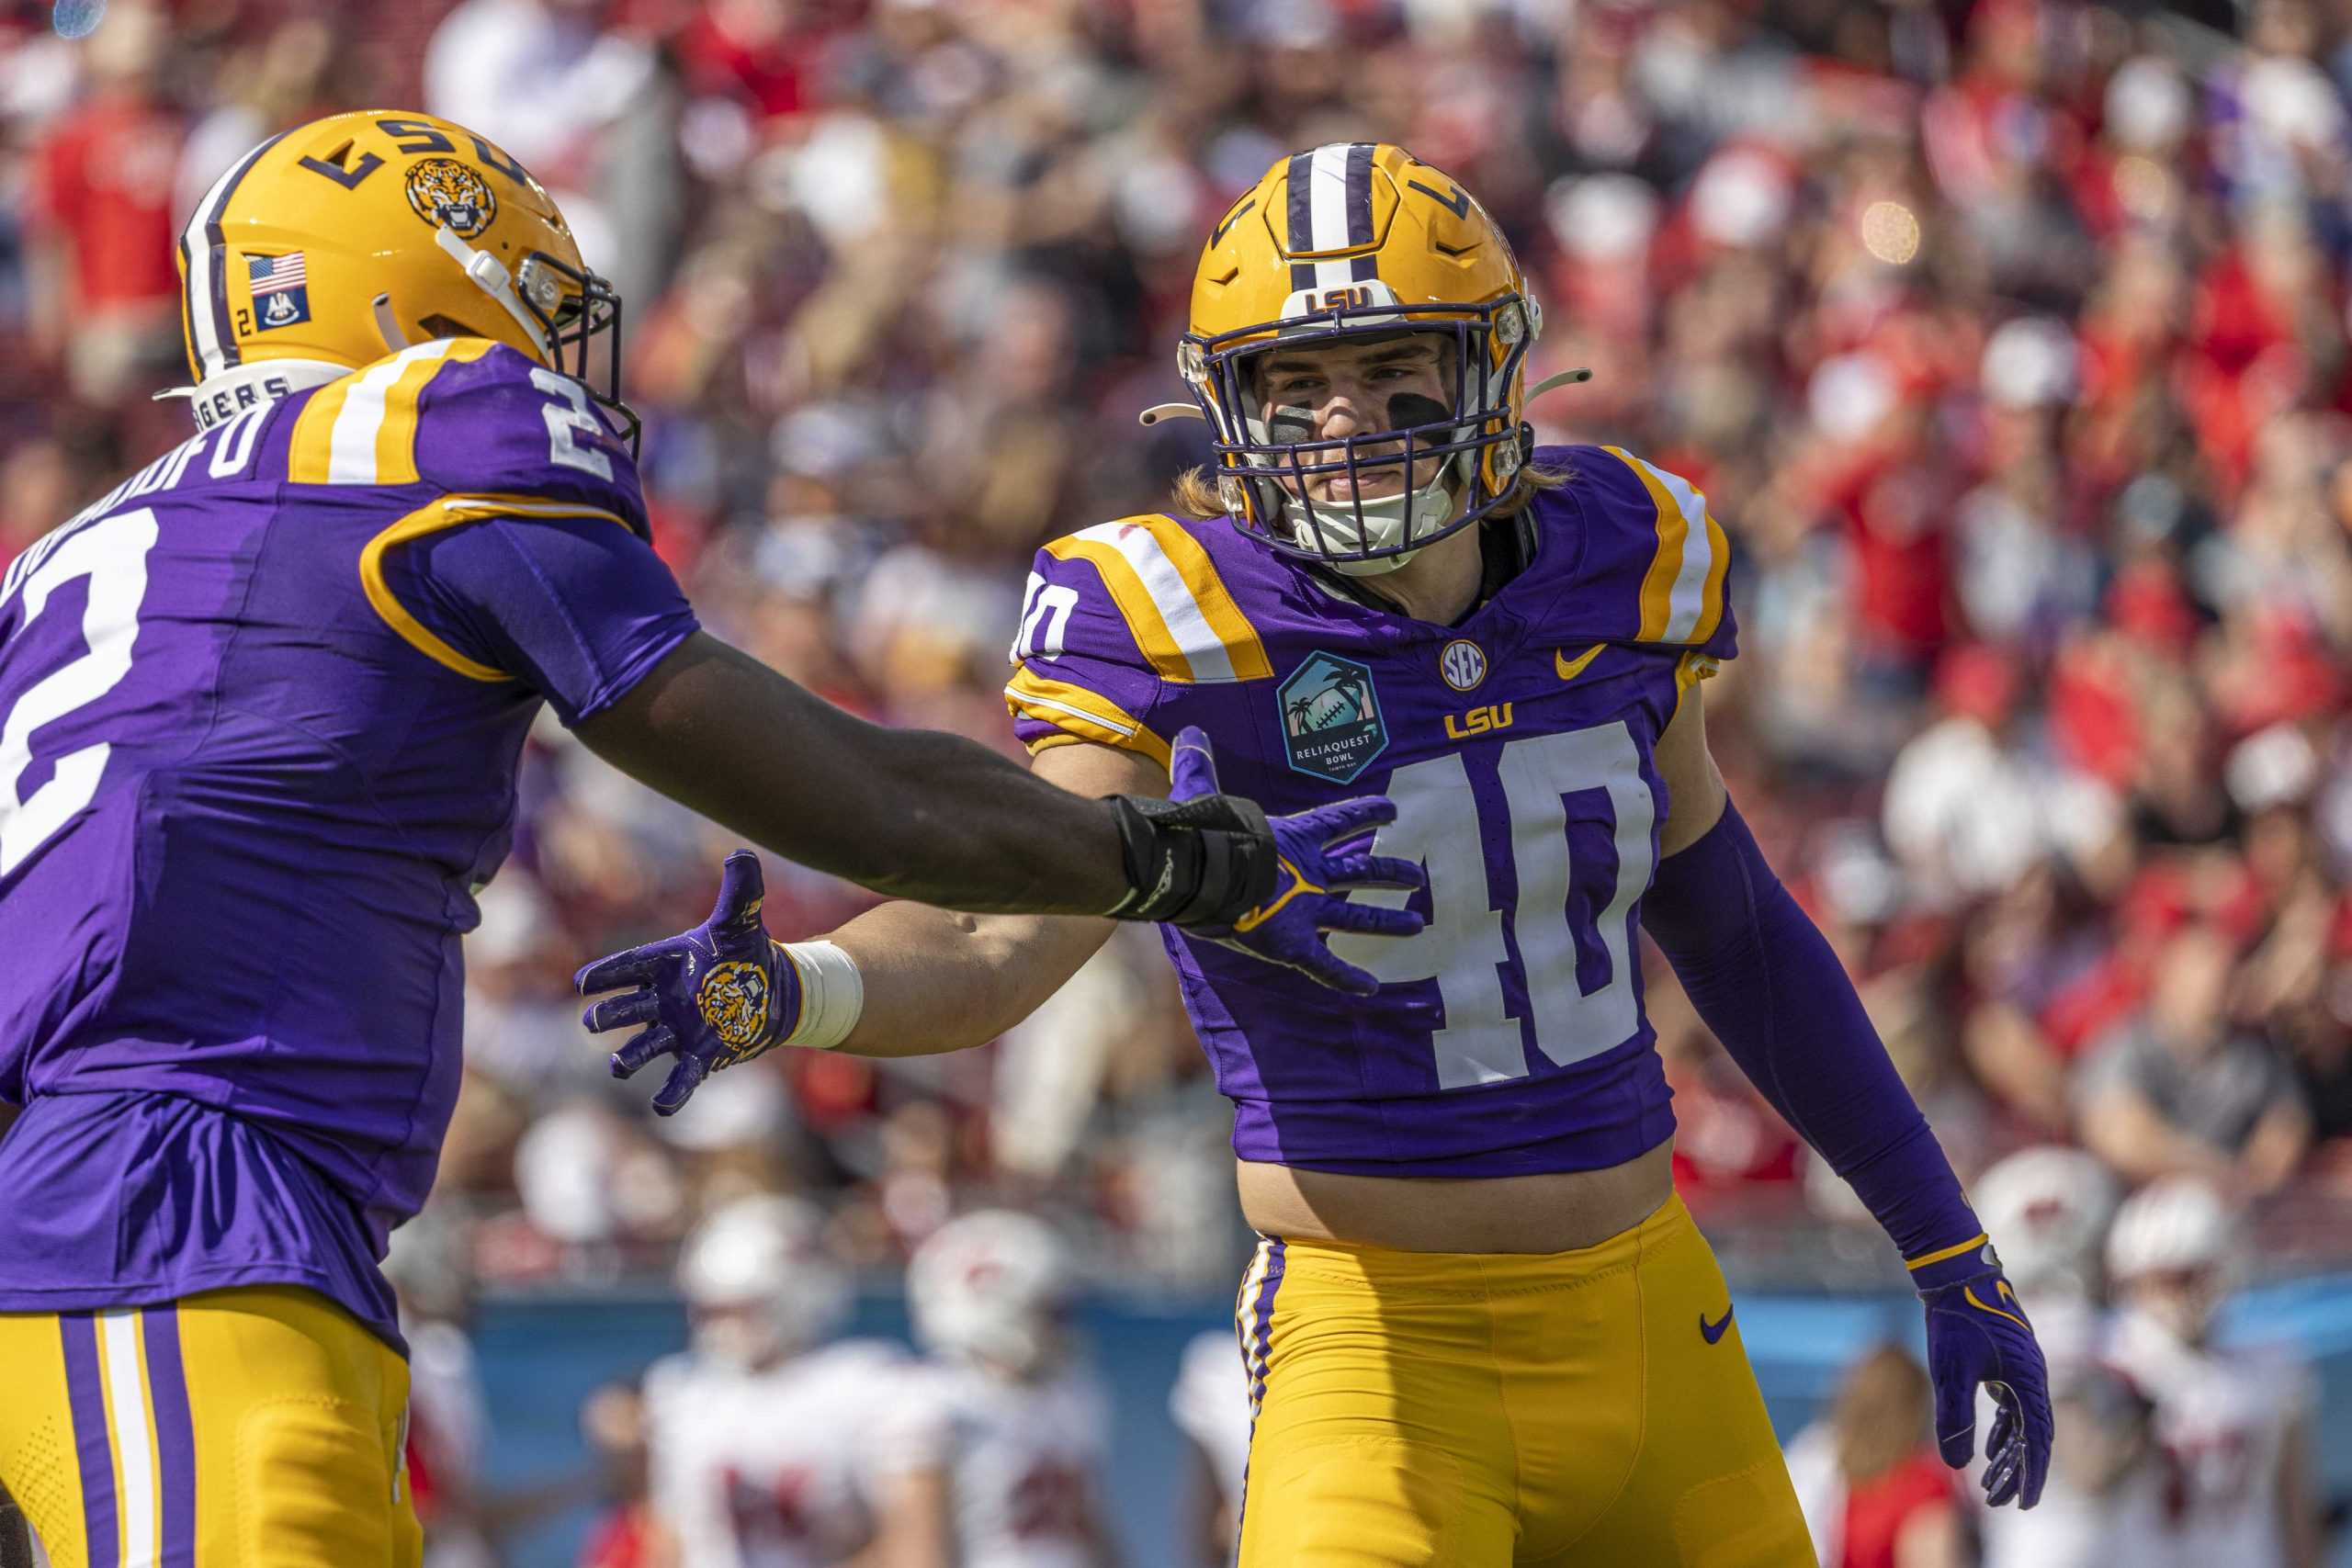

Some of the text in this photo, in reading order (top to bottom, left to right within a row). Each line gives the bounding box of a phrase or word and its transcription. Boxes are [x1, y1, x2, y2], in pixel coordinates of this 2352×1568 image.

[298, 120, 528, 191] LSU
[1306, 286, 1374, 314] LSU
[236, 309, 251, 337] 2
[194, 378, 289, 429] GERS
[529, 367, 613, 482] 2
[1444, 644, 1482, 687] SEC
[0, 507, 159, 875] 2
[1444, 702, 1513, 739] LSU
[1296, 735, 1370, 760] RELIAQUEST
[1326, 752, 1354, 764] BOWL
[1326, 720, 1654, 1089] 40
